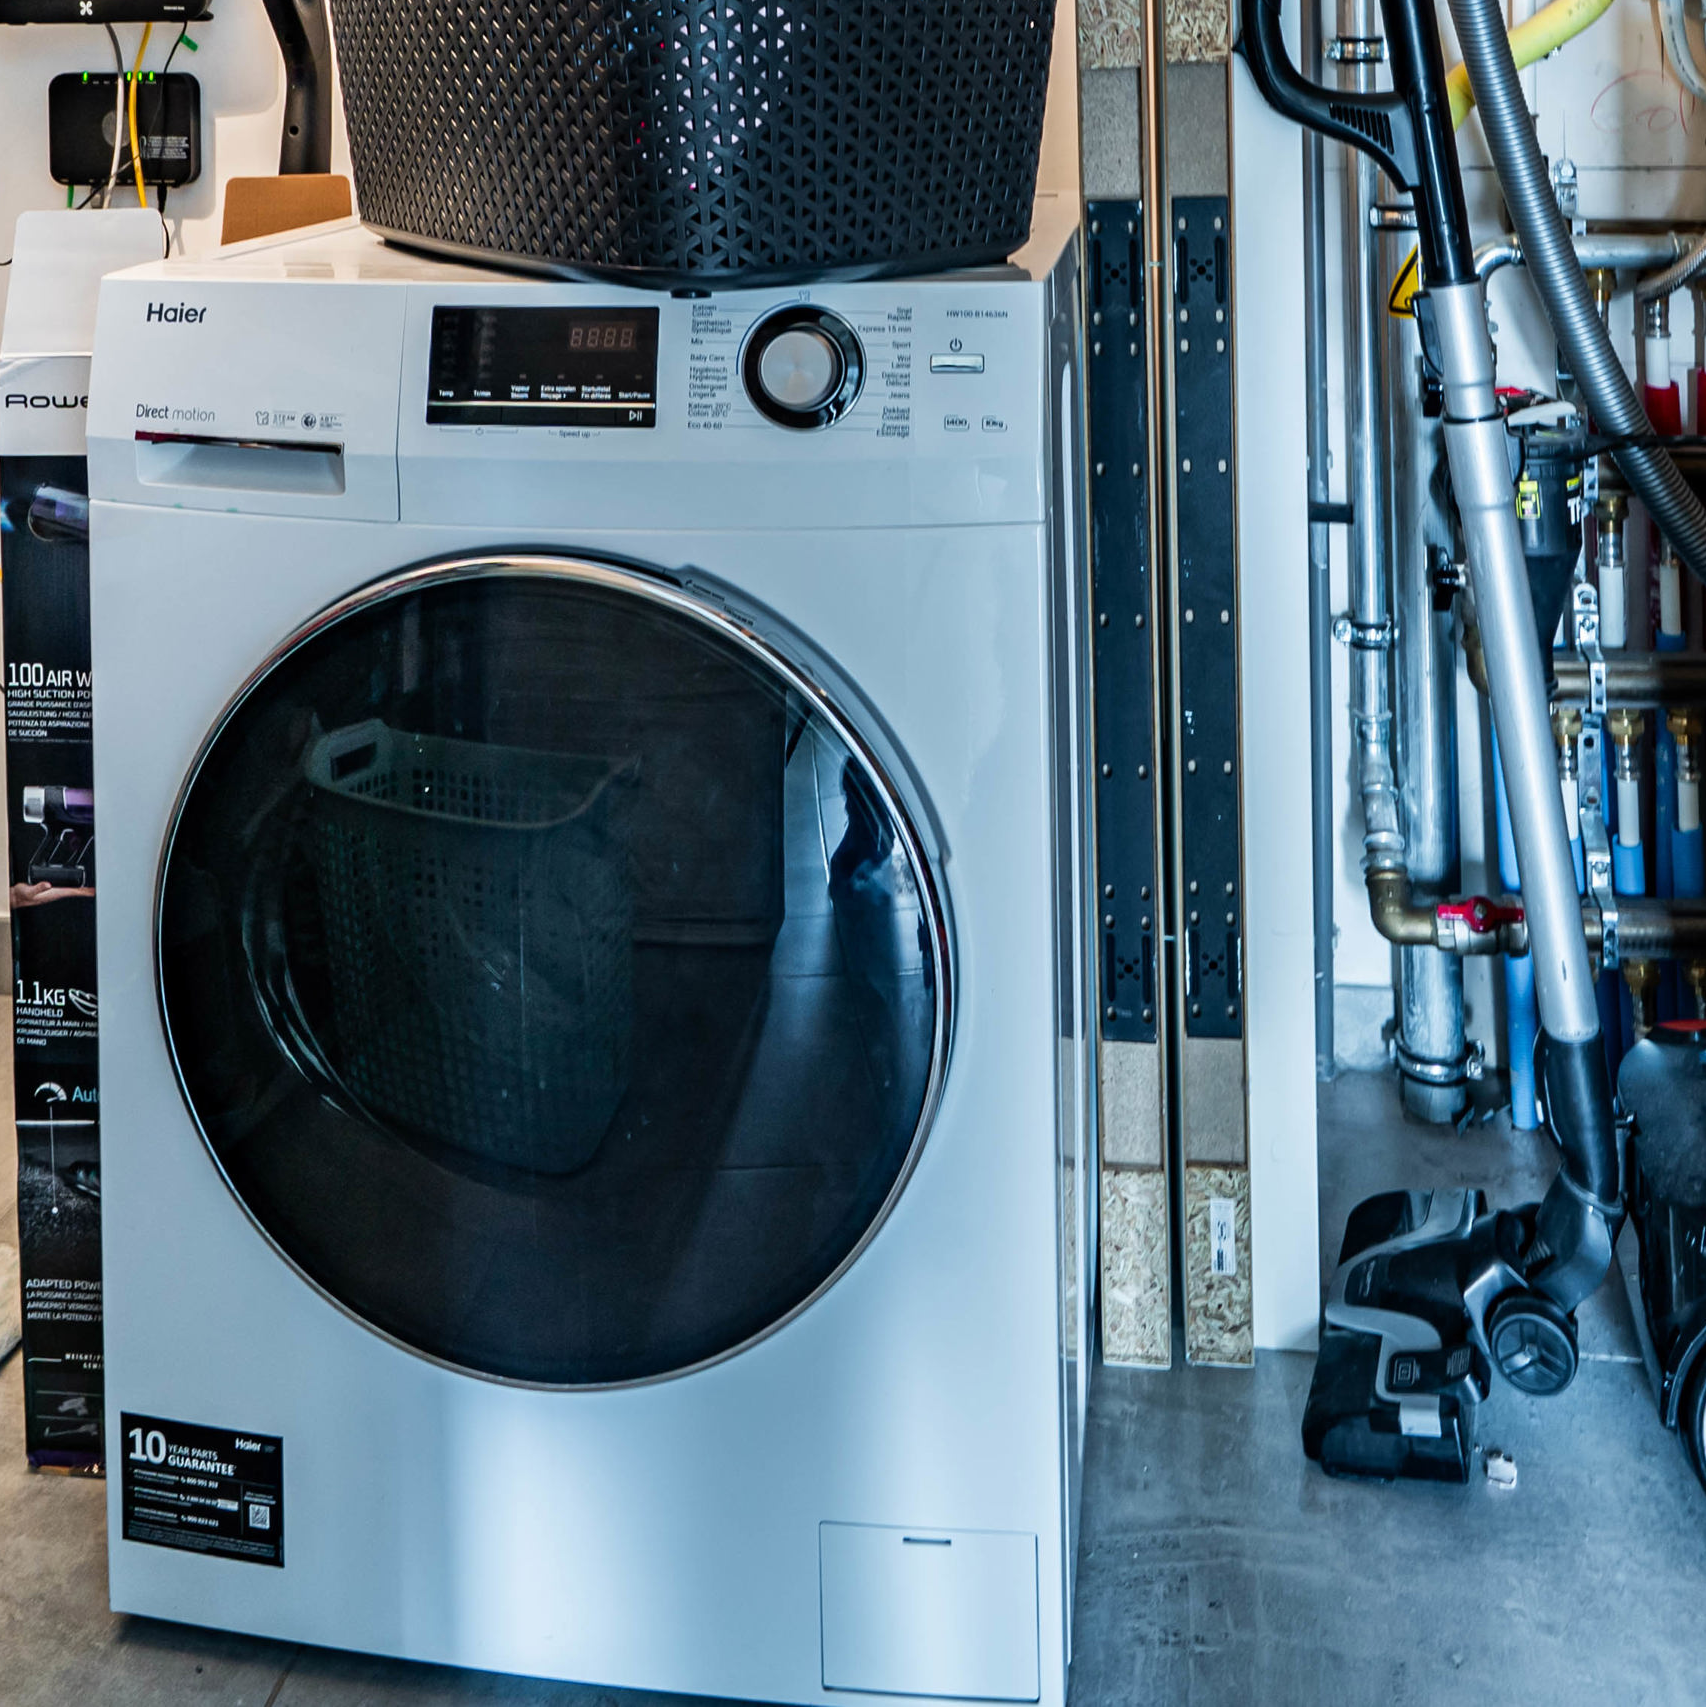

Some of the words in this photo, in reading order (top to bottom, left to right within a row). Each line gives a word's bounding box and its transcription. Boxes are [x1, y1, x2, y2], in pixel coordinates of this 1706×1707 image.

[146, 303, 206, 323] Haier
[690, 354, 707, 362] Baby
[136, 404, 168, 419] Direct
[172, 408, 215, 422] motion
[8, 663, 43, 687] 100
[46, 670, 72, 687] AIR
[7, 690, 31, 698] HIGH
[33, 690, 74, 699] SUCTION
[16, 1007, 63, 1018] HANDHELD
[26, 1279, 72, 1290] ADAPTED
[129, 1427, 167, 1465] 10
[168, 1444, 189, 1456] YEAR
[191, 1447, 218, 1461] PARTS
[235, 1437, 262, 1452] Haier
